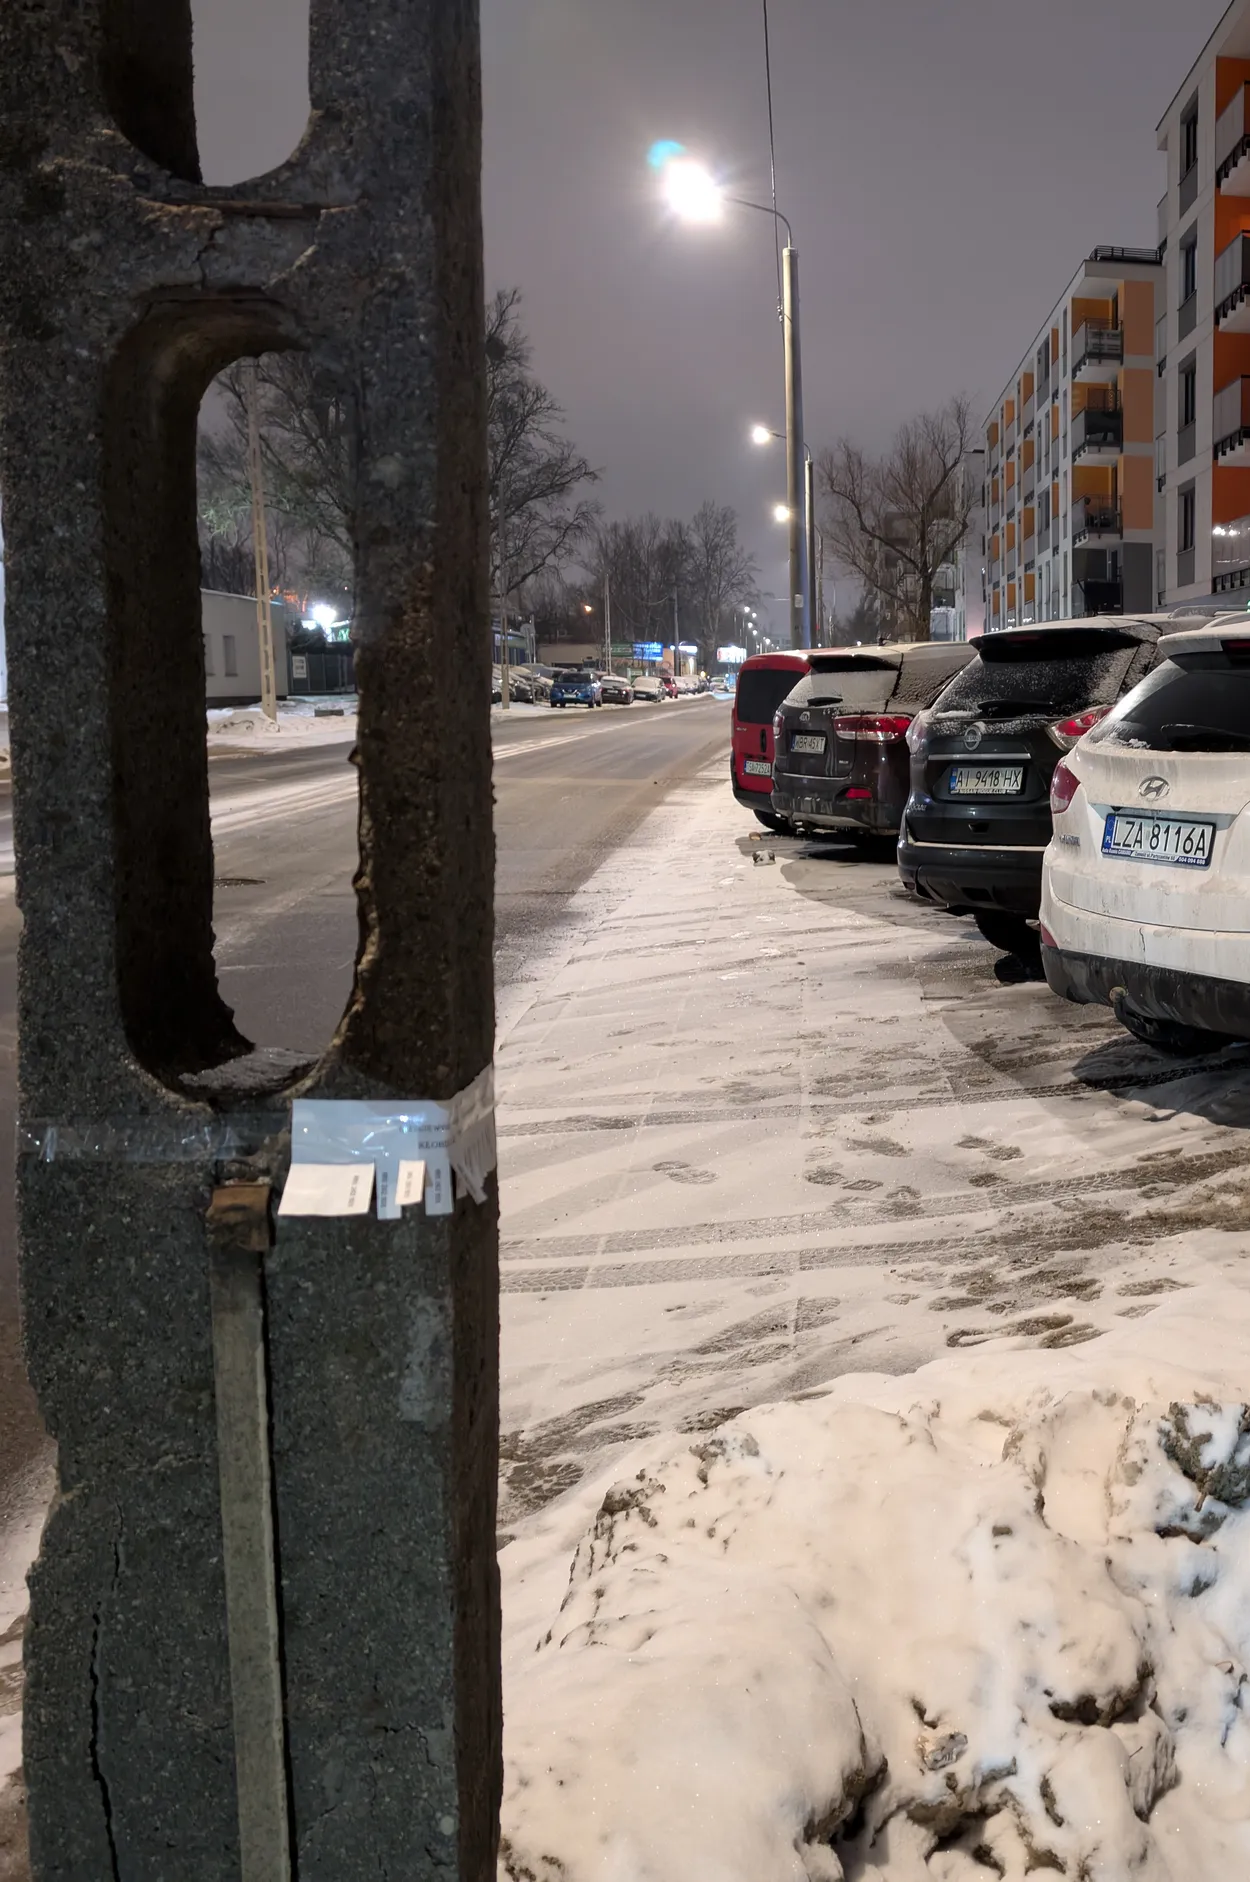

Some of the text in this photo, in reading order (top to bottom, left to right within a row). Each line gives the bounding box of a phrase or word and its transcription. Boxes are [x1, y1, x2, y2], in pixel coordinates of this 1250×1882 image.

[975, 769, 1000, 788] 9418
[1003, 769, 1021, 788] HX
[1105, 835, 1112, 843] PL
[1113, 819, 1206, 857] LZA 8116A
